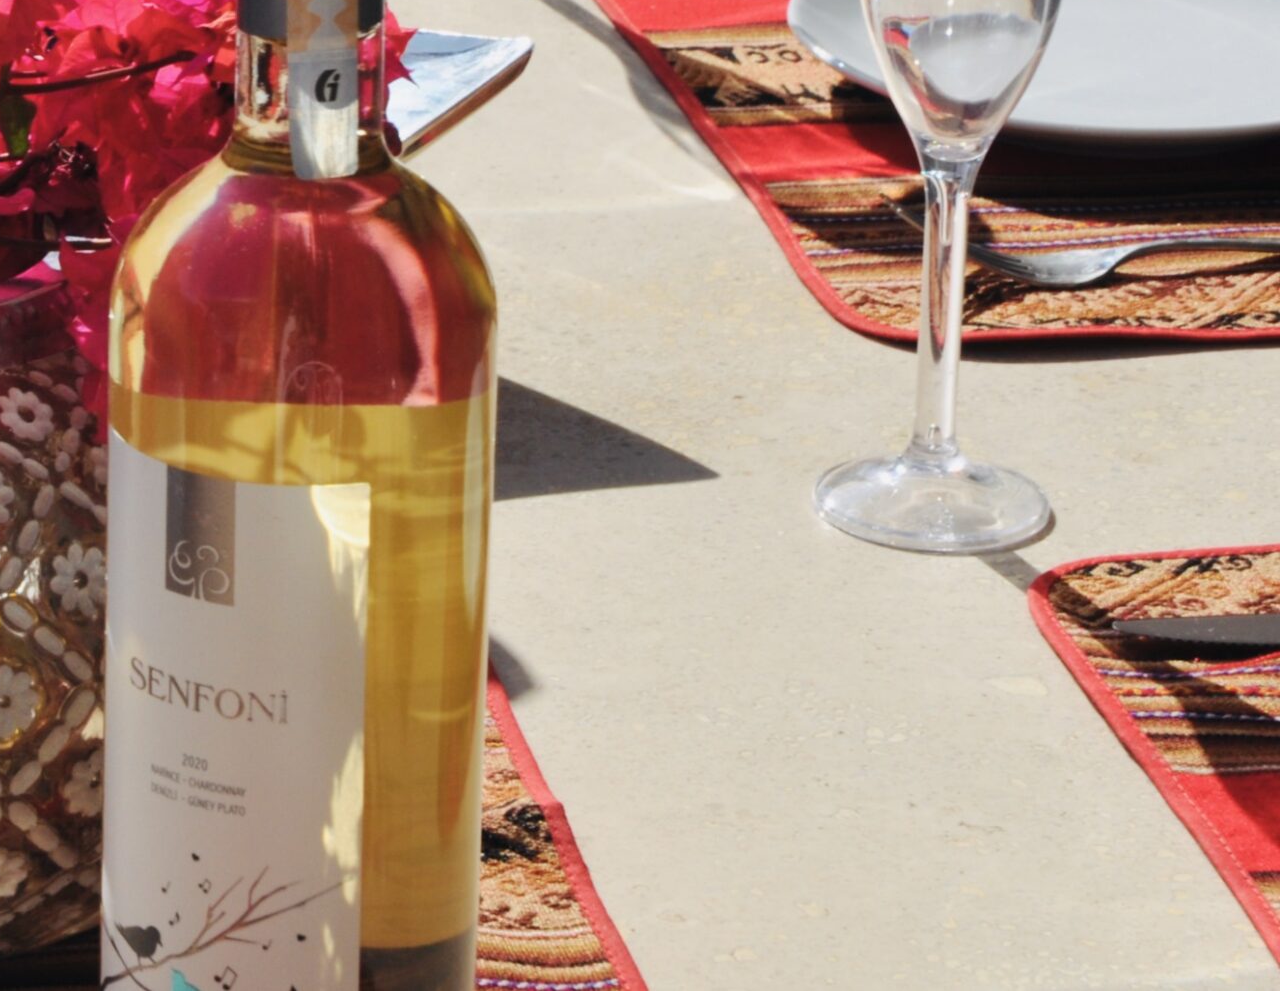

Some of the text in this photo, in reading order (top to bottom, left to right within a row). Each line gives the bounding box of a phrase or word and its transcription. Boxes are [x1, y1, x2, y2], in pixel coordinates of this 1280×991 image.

[129, 656, 289, 725] SENFONİ
[181, 752, 208, 771] 2020
[188, 776, 246, 797] CHARDONNAY
[217, 802, 247, 818] PLATO
